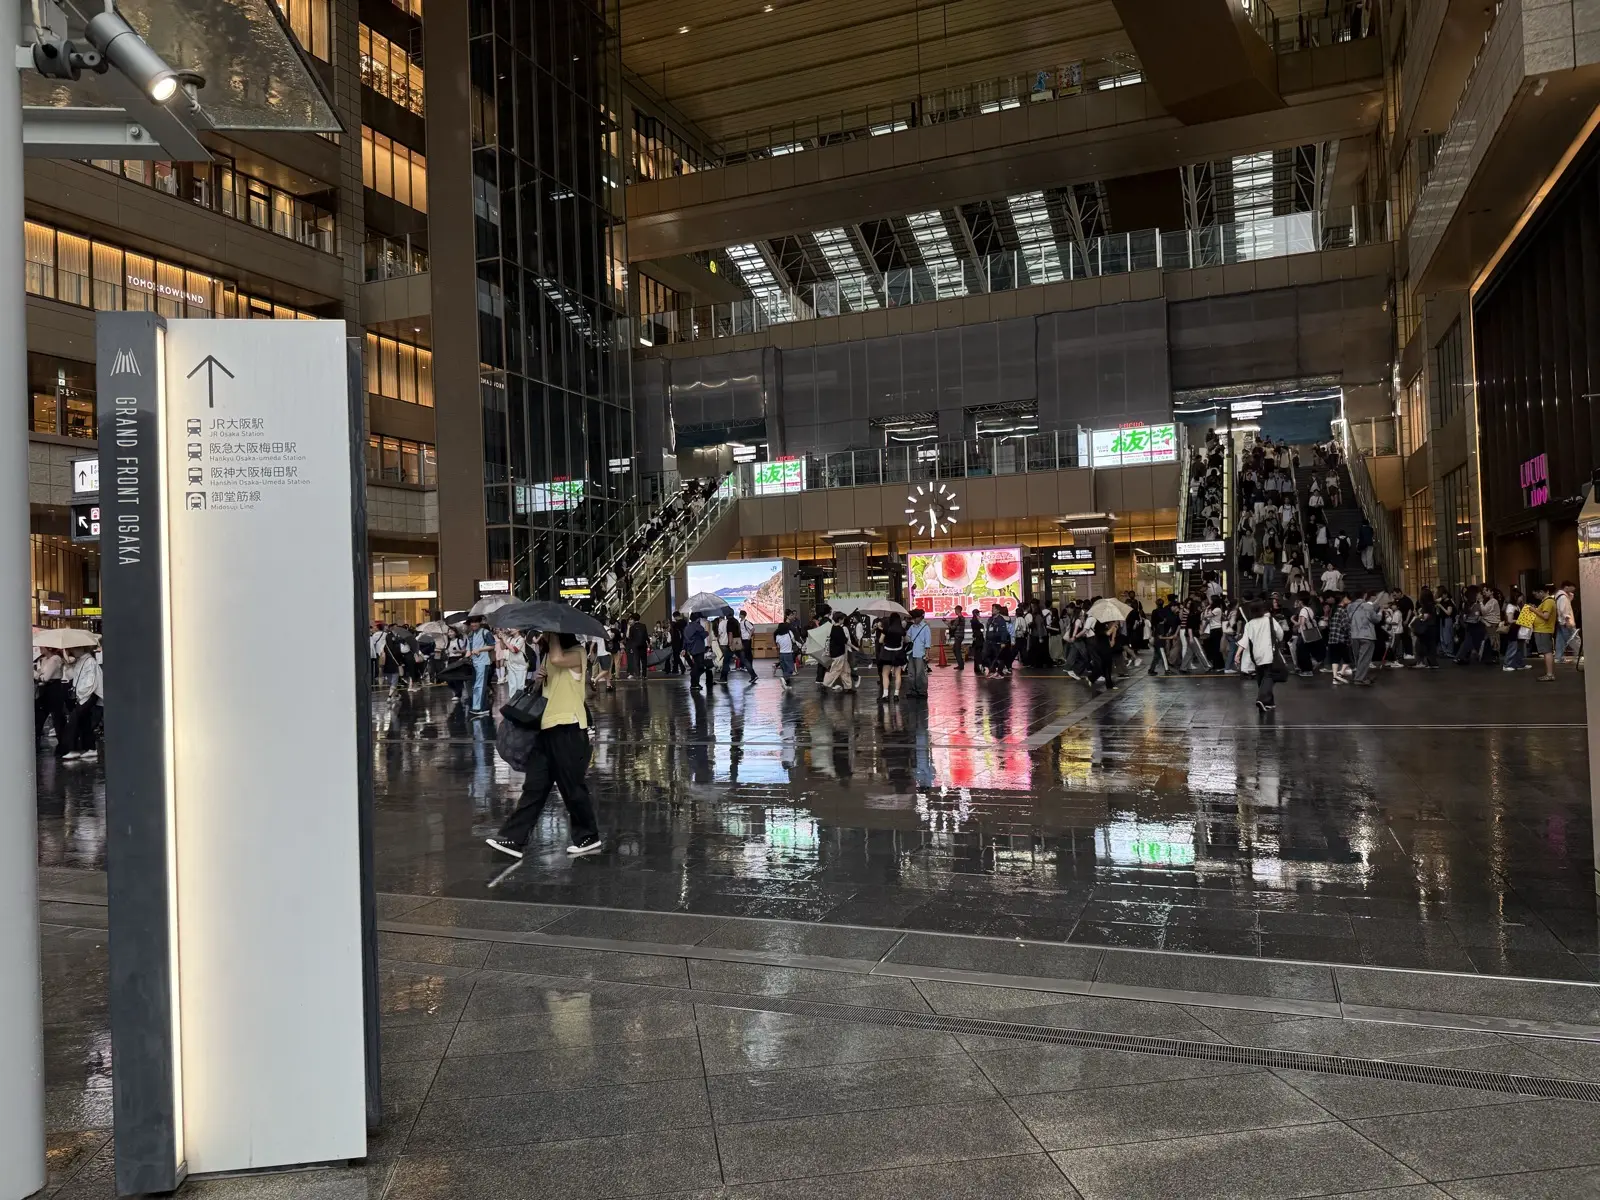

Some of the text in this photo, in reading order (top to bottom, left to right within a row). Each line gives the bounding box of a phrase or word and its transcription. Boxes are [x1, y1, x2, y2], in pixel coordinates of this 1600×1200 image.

[209, 418, 264, 430] JR大阪駅
[1111, 427, 1173, 453] お友だち
[209, 442, 297, 454] 阪急大阪梅田駅
[210, 466, 298, 478] 阪神大阪梅田駅
[115, 397, 141, 565] GRAND FRONT OSAKA
[211, 491, 262, 502] 御堂筋線
[210, 503, 238, 511] Midosuji
